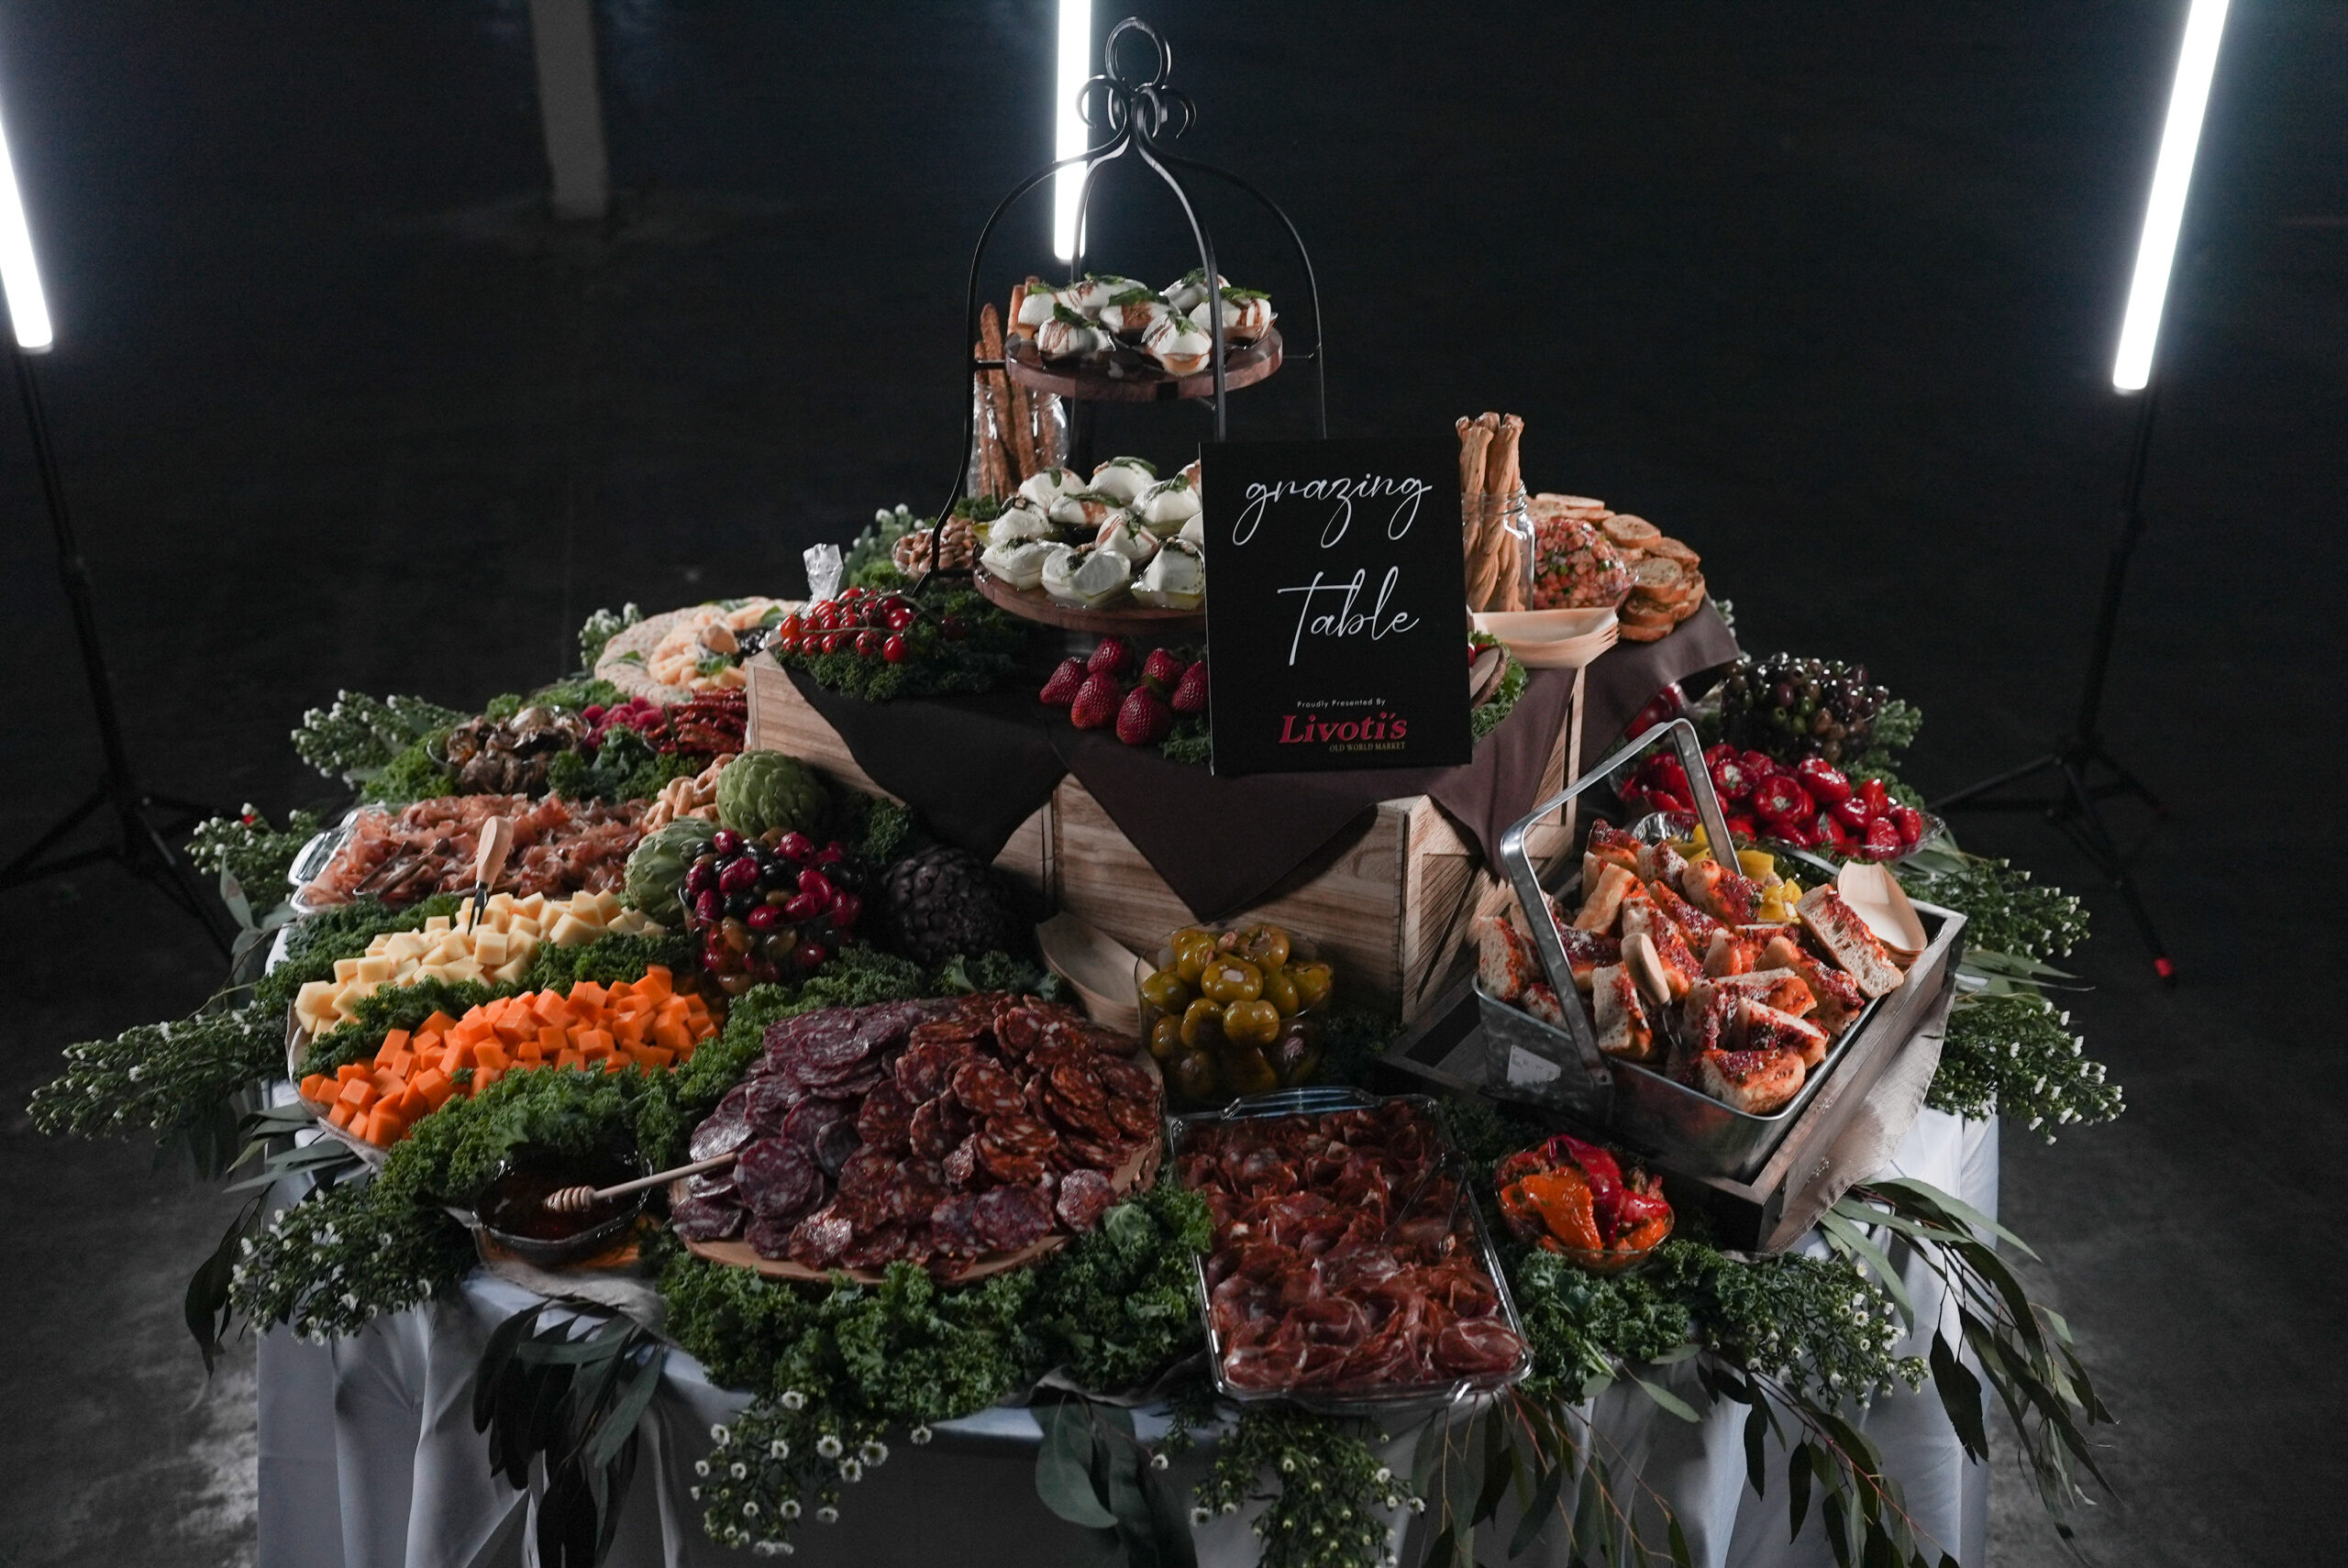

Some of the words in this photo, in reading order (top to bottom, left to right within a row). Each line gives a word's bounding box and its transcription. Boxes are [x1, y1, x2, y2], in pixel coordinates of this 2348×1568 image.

[1232, 472, 1433, 549] grazing
[1277, 565, 1420, 667] Table
[1297, 700, 1329, 709] Proudly
[1332, 698, 1373, 707] Presented
[1376, 697, 1386, 706] By
[1279, 712, 1408, 744] Livoti's
[1329, 744, 1345, 752] OLD
[1347, 743, 1373, 752] WORLD
[1375, 741, 1406, 751] MARKET
